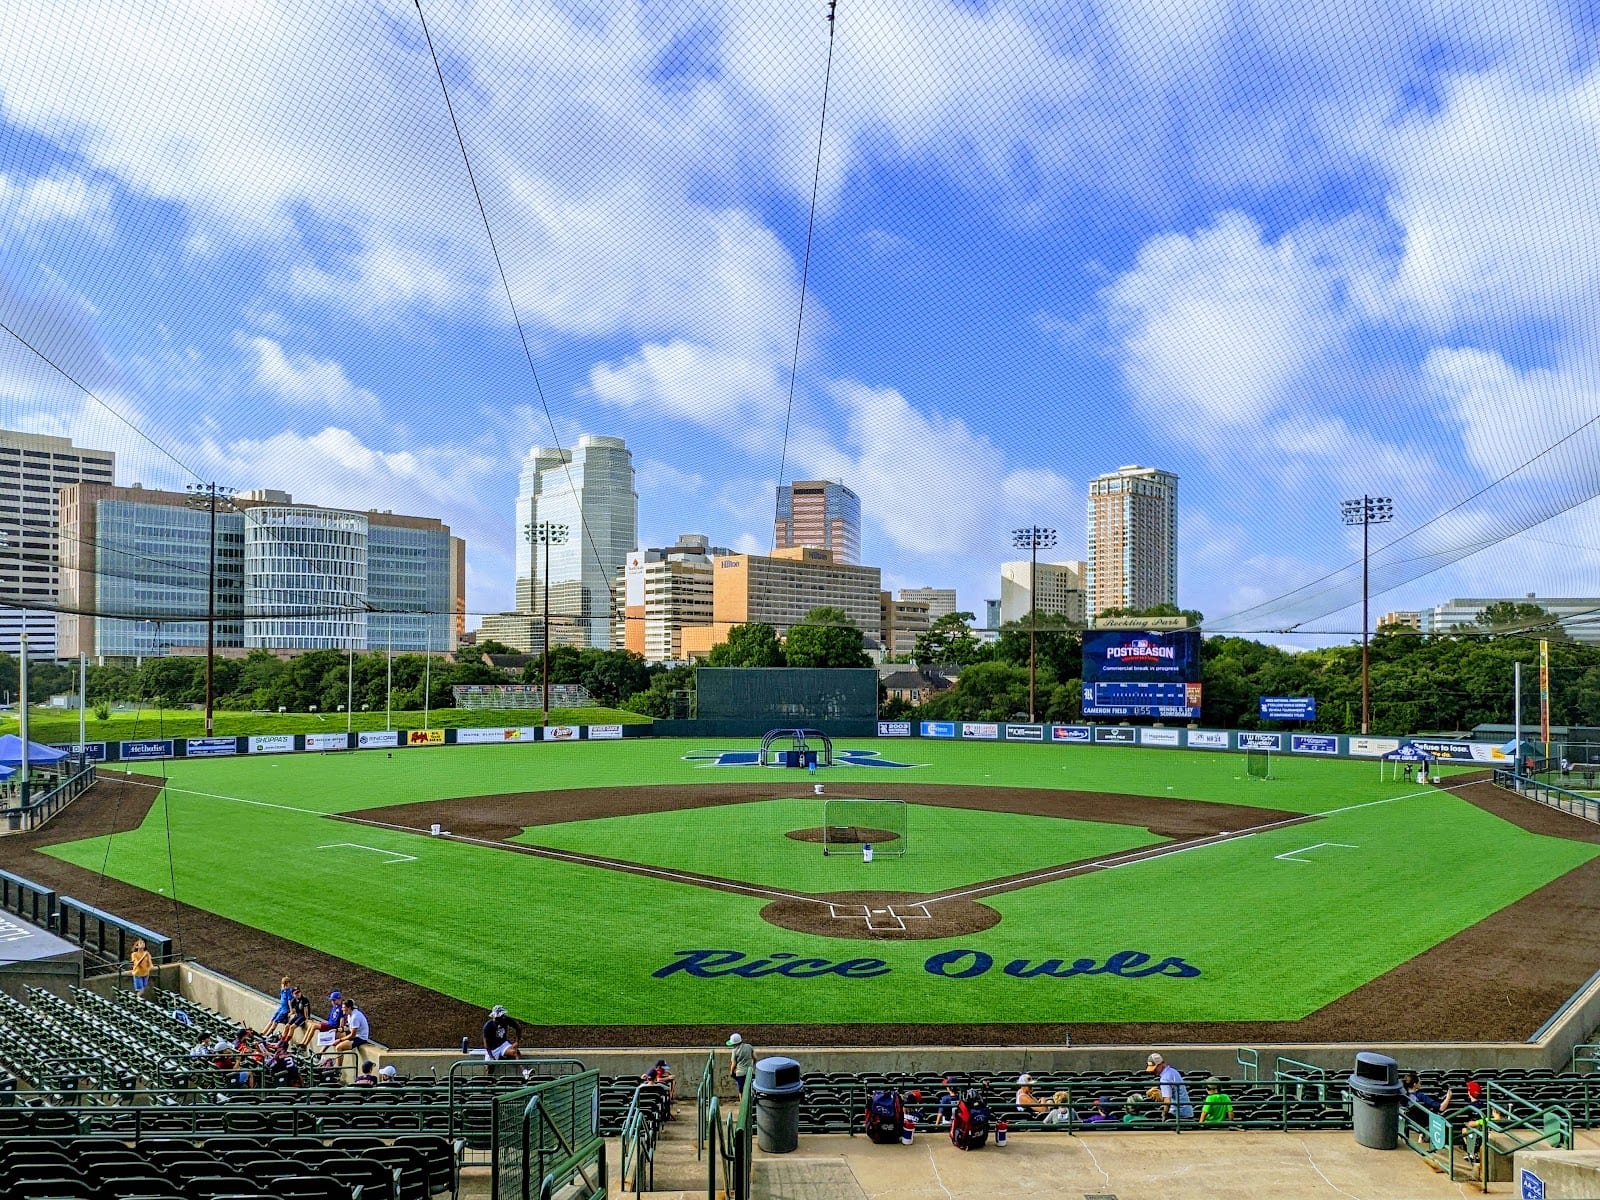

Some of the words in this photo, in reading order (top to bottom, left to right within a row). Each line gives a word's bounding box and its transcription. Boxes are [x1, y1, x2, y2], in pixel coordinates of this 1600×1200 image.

[721, 560, 740, 569] Hilton
[1106, 647, 1174, 659] POSTSEASON
[130, 743, 166, 753] Methodist
[1414, 743, 1440, 751] Refuse
[1450, 744, 1469, 753] lose.
[652, 950, 892, 979] Rice
[924, 949, 1202, 979] Owls
